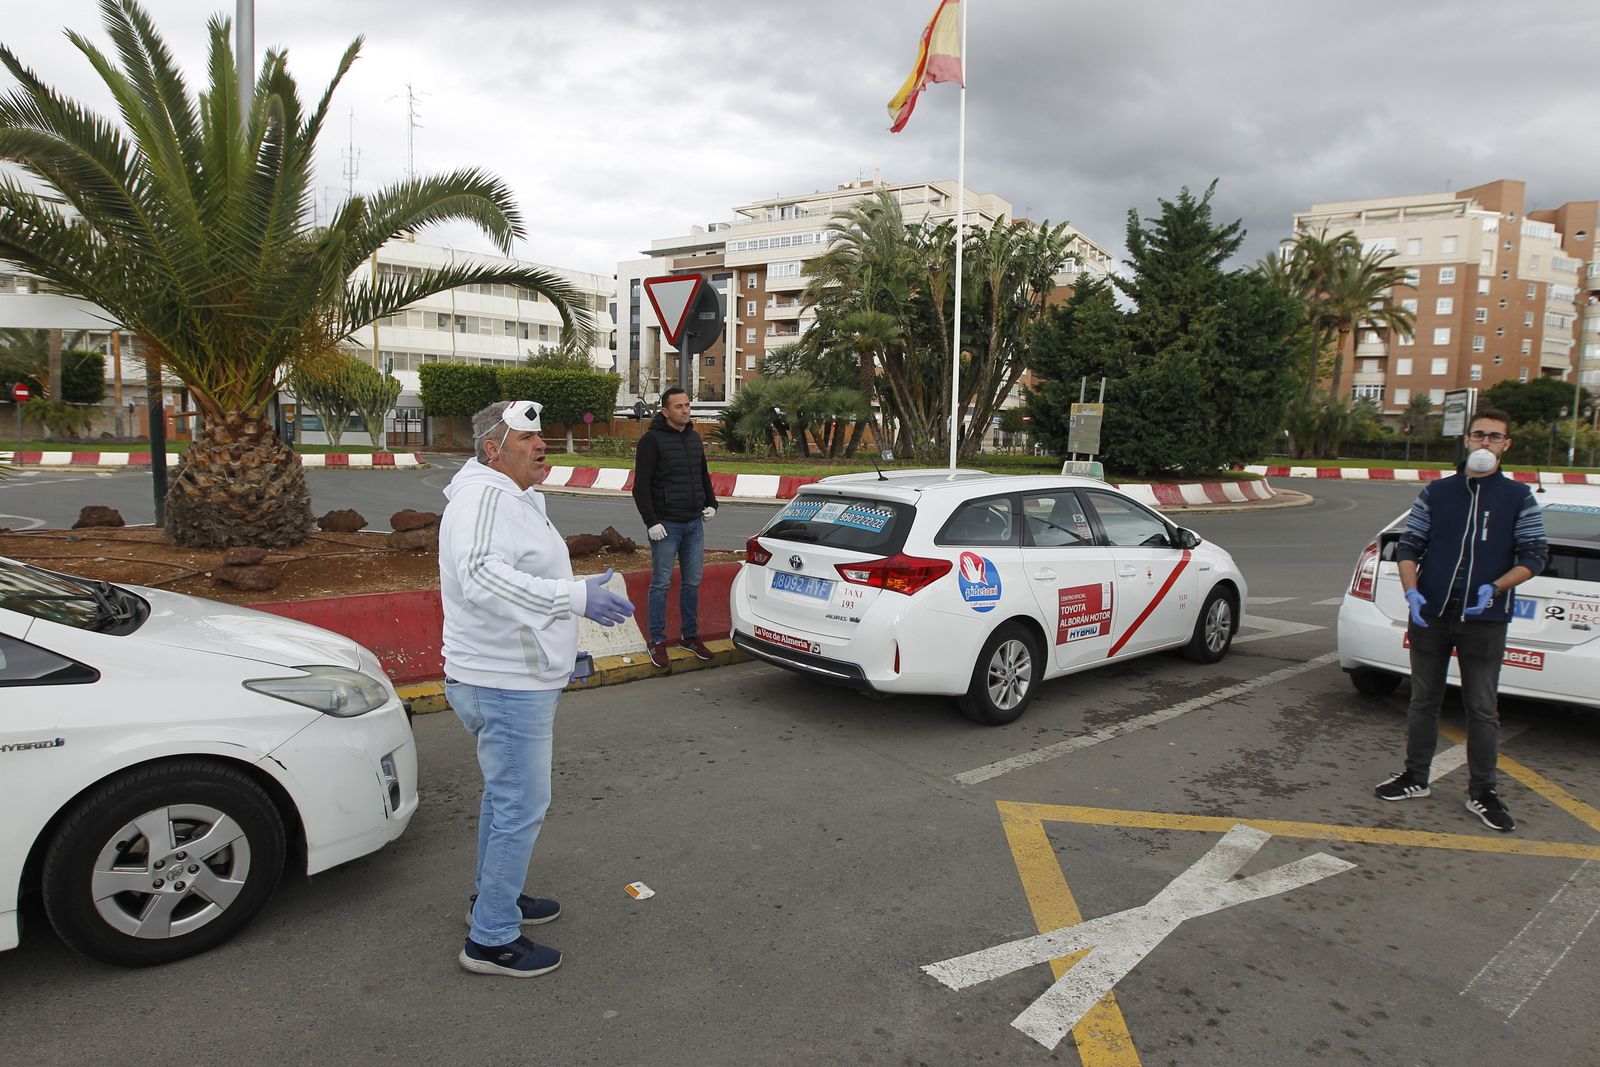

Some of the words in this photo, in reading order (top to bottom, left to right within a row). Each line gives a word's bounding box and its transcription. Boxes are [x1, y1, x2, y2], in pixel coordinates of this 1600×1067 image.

[778, 574, 805, 592] 8092
[806, 580, 829, 596] HYF
[965, 584, 998, 600] pidetaxi
[844, 588, 863, 598] TAXI
[841, 600, 855, 609] 193
[1061, 603, 1086, 615] TOYOTA
[1569, 602, 1599, 612] TAXI
[1060, 613, 1089, 628] ALBORÁN
[1090, 611, 1111, 622] MOTOR
[754, 626, 762, 635] La
[762, 629, 773, 639] Voz
[773, 632, 781, 640] de
[1069, 625, 1098, 639] HYBRID
